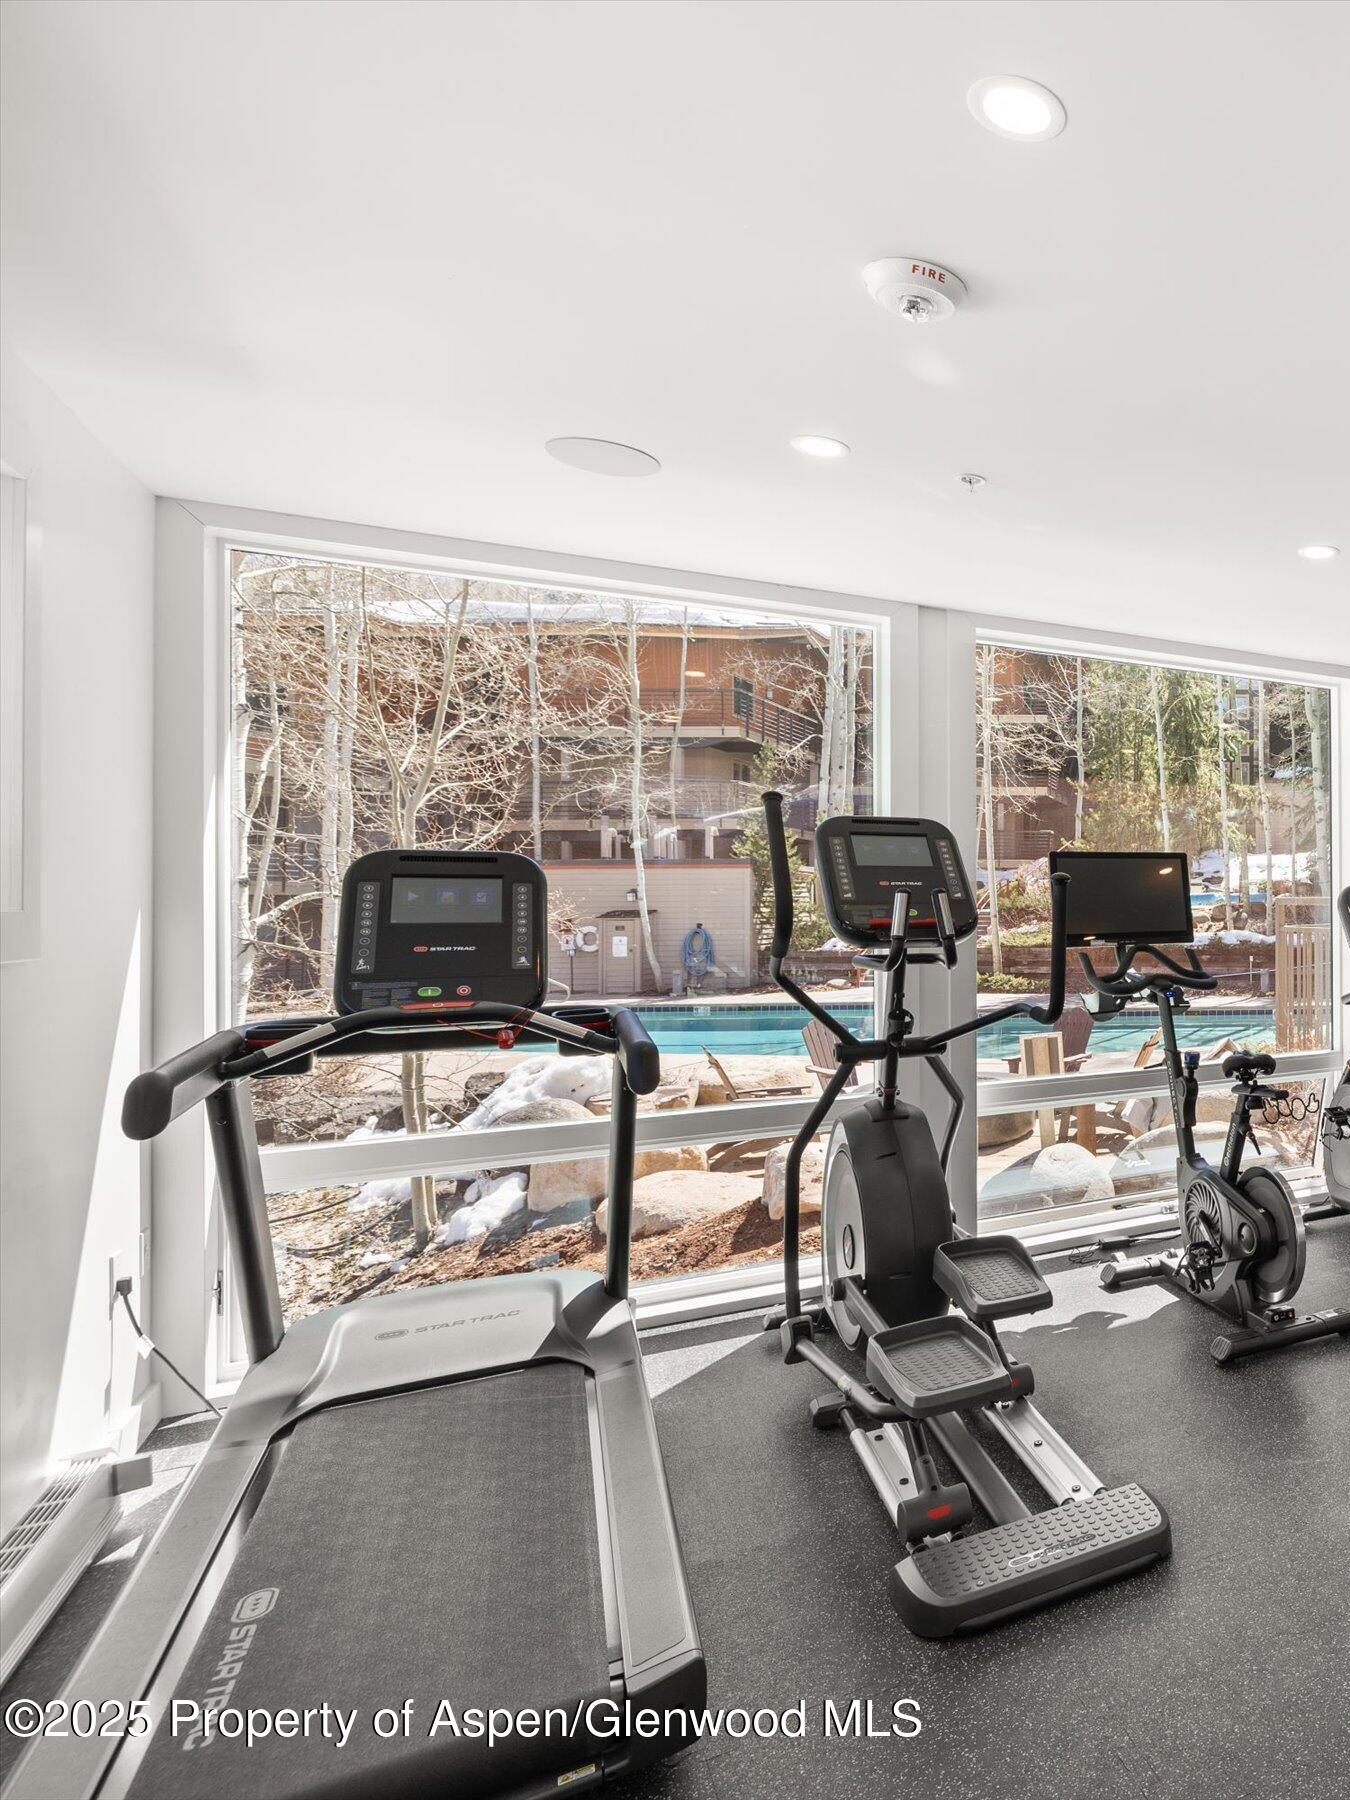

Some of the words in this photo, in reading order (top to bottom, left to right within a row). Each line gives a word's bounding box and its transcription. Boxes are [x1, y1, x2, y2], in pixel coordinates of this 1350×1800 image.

[911, 263, 946, 283] FIRE
[414, 1319, 466, 1334] STAR
[470, 1310, 521, 1324] TRAC
[211, 1624, 258, 1681] STAR
